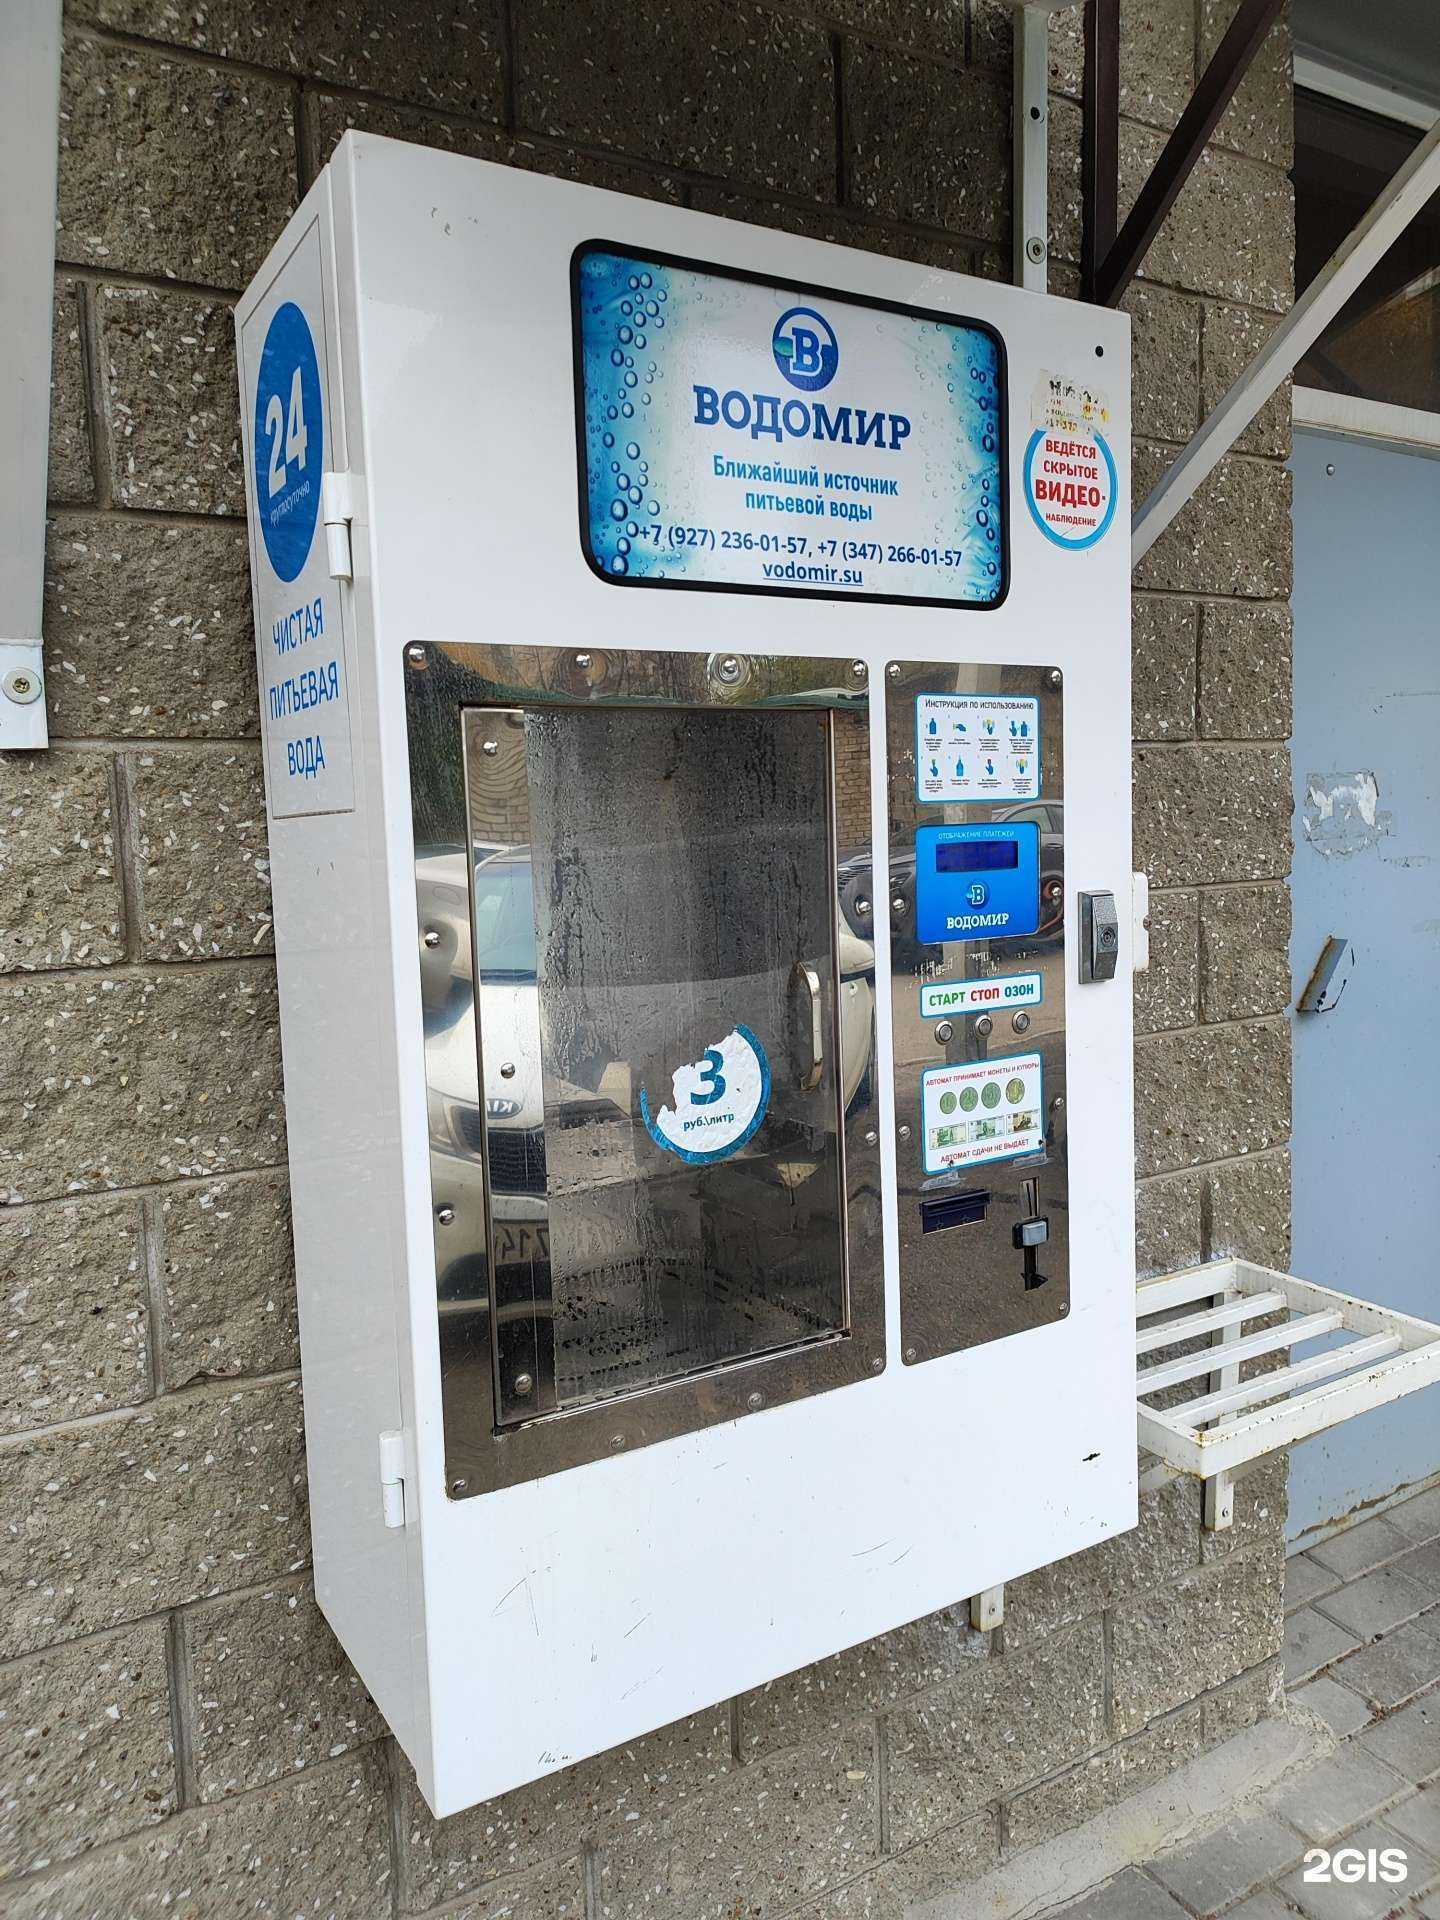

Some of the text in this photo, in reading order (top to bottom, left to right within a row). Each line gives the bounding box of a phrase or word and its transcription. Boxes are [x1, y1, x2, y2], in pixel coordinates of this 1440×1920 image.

[265, 365, 308, 499] 24
[692, 385, 912, 450] ВОДОМИР
[1045, 439, 1097, 460] ВЕДЁТСЯ
[713, 455, 899, 497] Ближайший источник
[1043, 460, 1098, 480] СКРЫТОЕ
[269, 479, 310, 528] круглосуточно
[745, 490, 873, 522] питьевой воды
[1035, 479, 1106, 508] ВИДЕО-
[1045, 513, 1097, 527] НАБЛЮДЕНИЕ
[638, 525, 963, 568] +7 (927) 236-01-57, +7 (347) 266-01-57
[762, 561, 864, 586] vodomir.su
[272, 598, 324, 657] ЧИСТАЯ
[269, 661, 339, 721] ПИТЬЕВАЯ
[287, 735, 326, 780] ВОДА
[946, 912, 1010, 930] ВОДОМИР
[929, 983, 1034, 1007] СТАРТ СТОП ОЗОН
[690, 1049, 727, 1105] 3
[925, 1076, 952, 1087] АВТОМАТ
[953, 1071, 987, 1083] ПРИНИМАЕТ
[987, 1066, 1011, 1077] МОНЕТЫ
[1016, 1062, 1040, 1072] КУПЮРЫ
[683, 1112, 735, 1132] руб.\литр
[940, 1138, 1029, 1164] АВТОМАТ СДАЧИ НЕ ВЫДАЕТ
